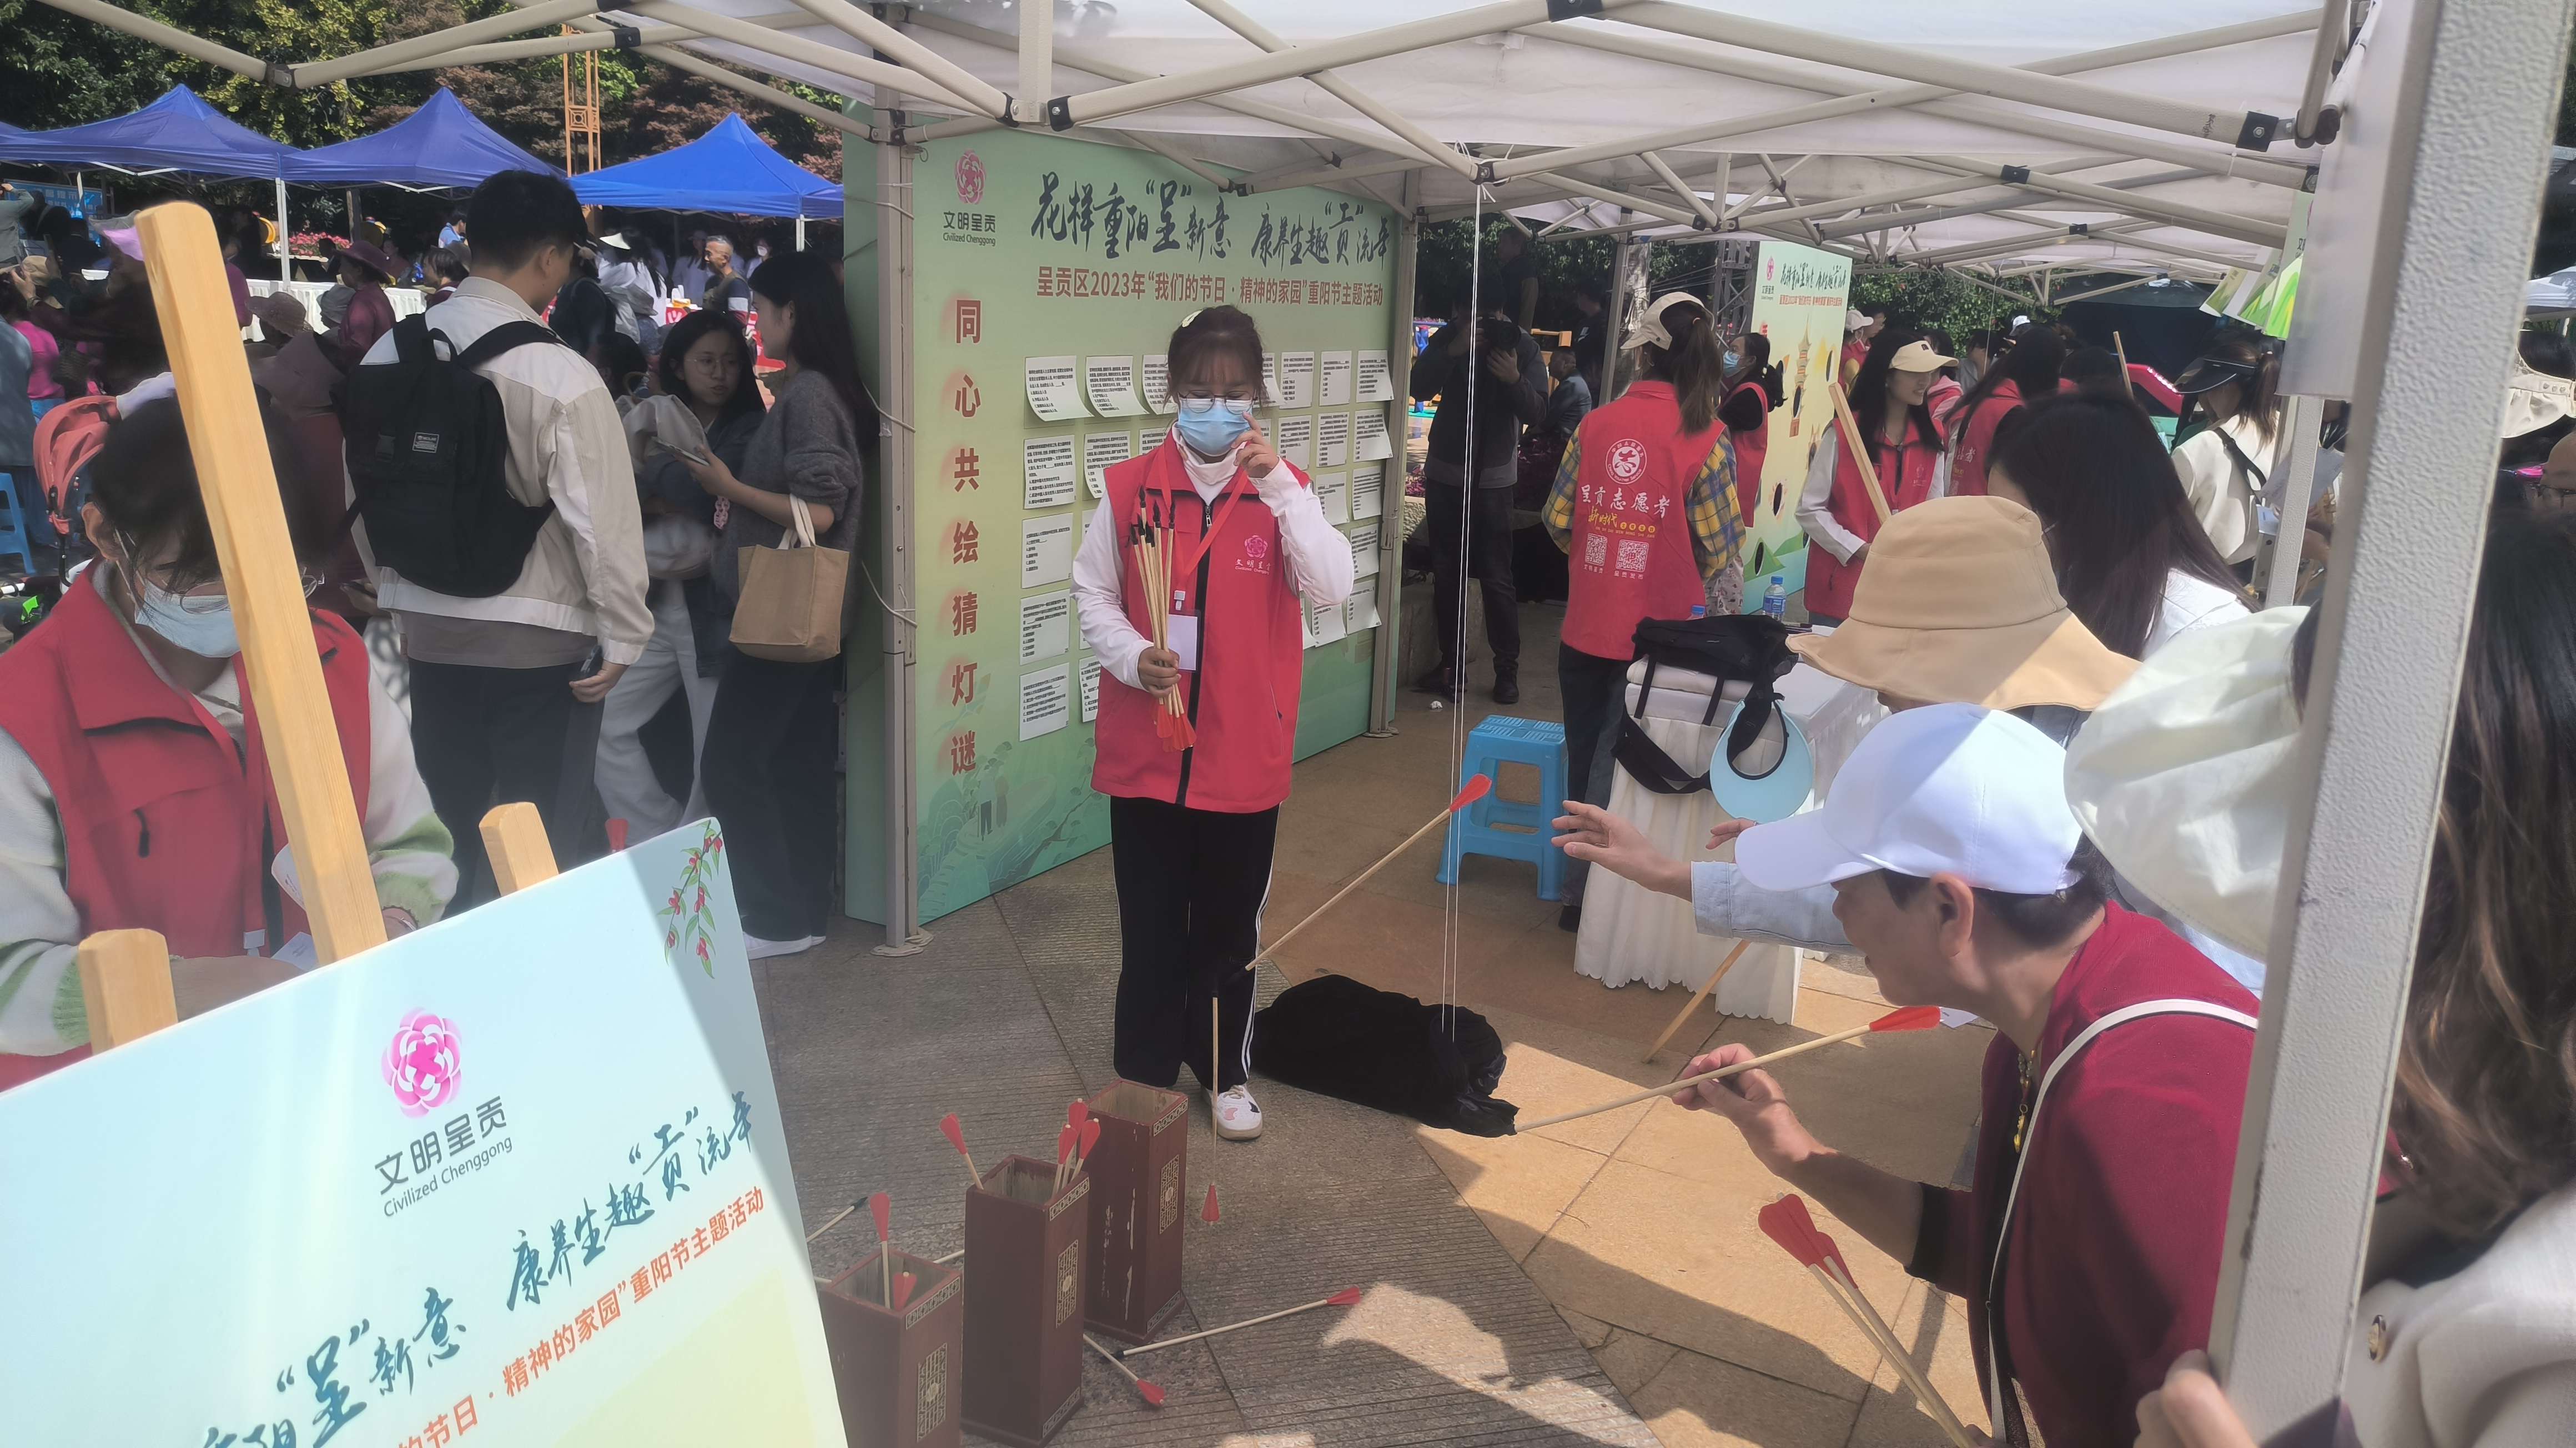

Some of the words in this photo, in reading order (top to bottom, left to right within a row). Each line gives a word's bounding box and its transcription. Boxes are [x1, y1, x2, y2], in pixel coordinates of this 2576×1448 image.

[943, 210, 996, 233] 文明呈贡
[943, 232, 965, 243] Civilized
[966, 234, 996, 247] Chenggong
[1581, 484, 1670, 519] 呈贡志愿者
[950, 300, 982, 776] 同心共绘猜灯谜
[375, 1095, 507, 1195] 文明呈贡
[384, 1174, 438, 1217] Civilized
[441, 1137, 512, 1184] Chenggong
